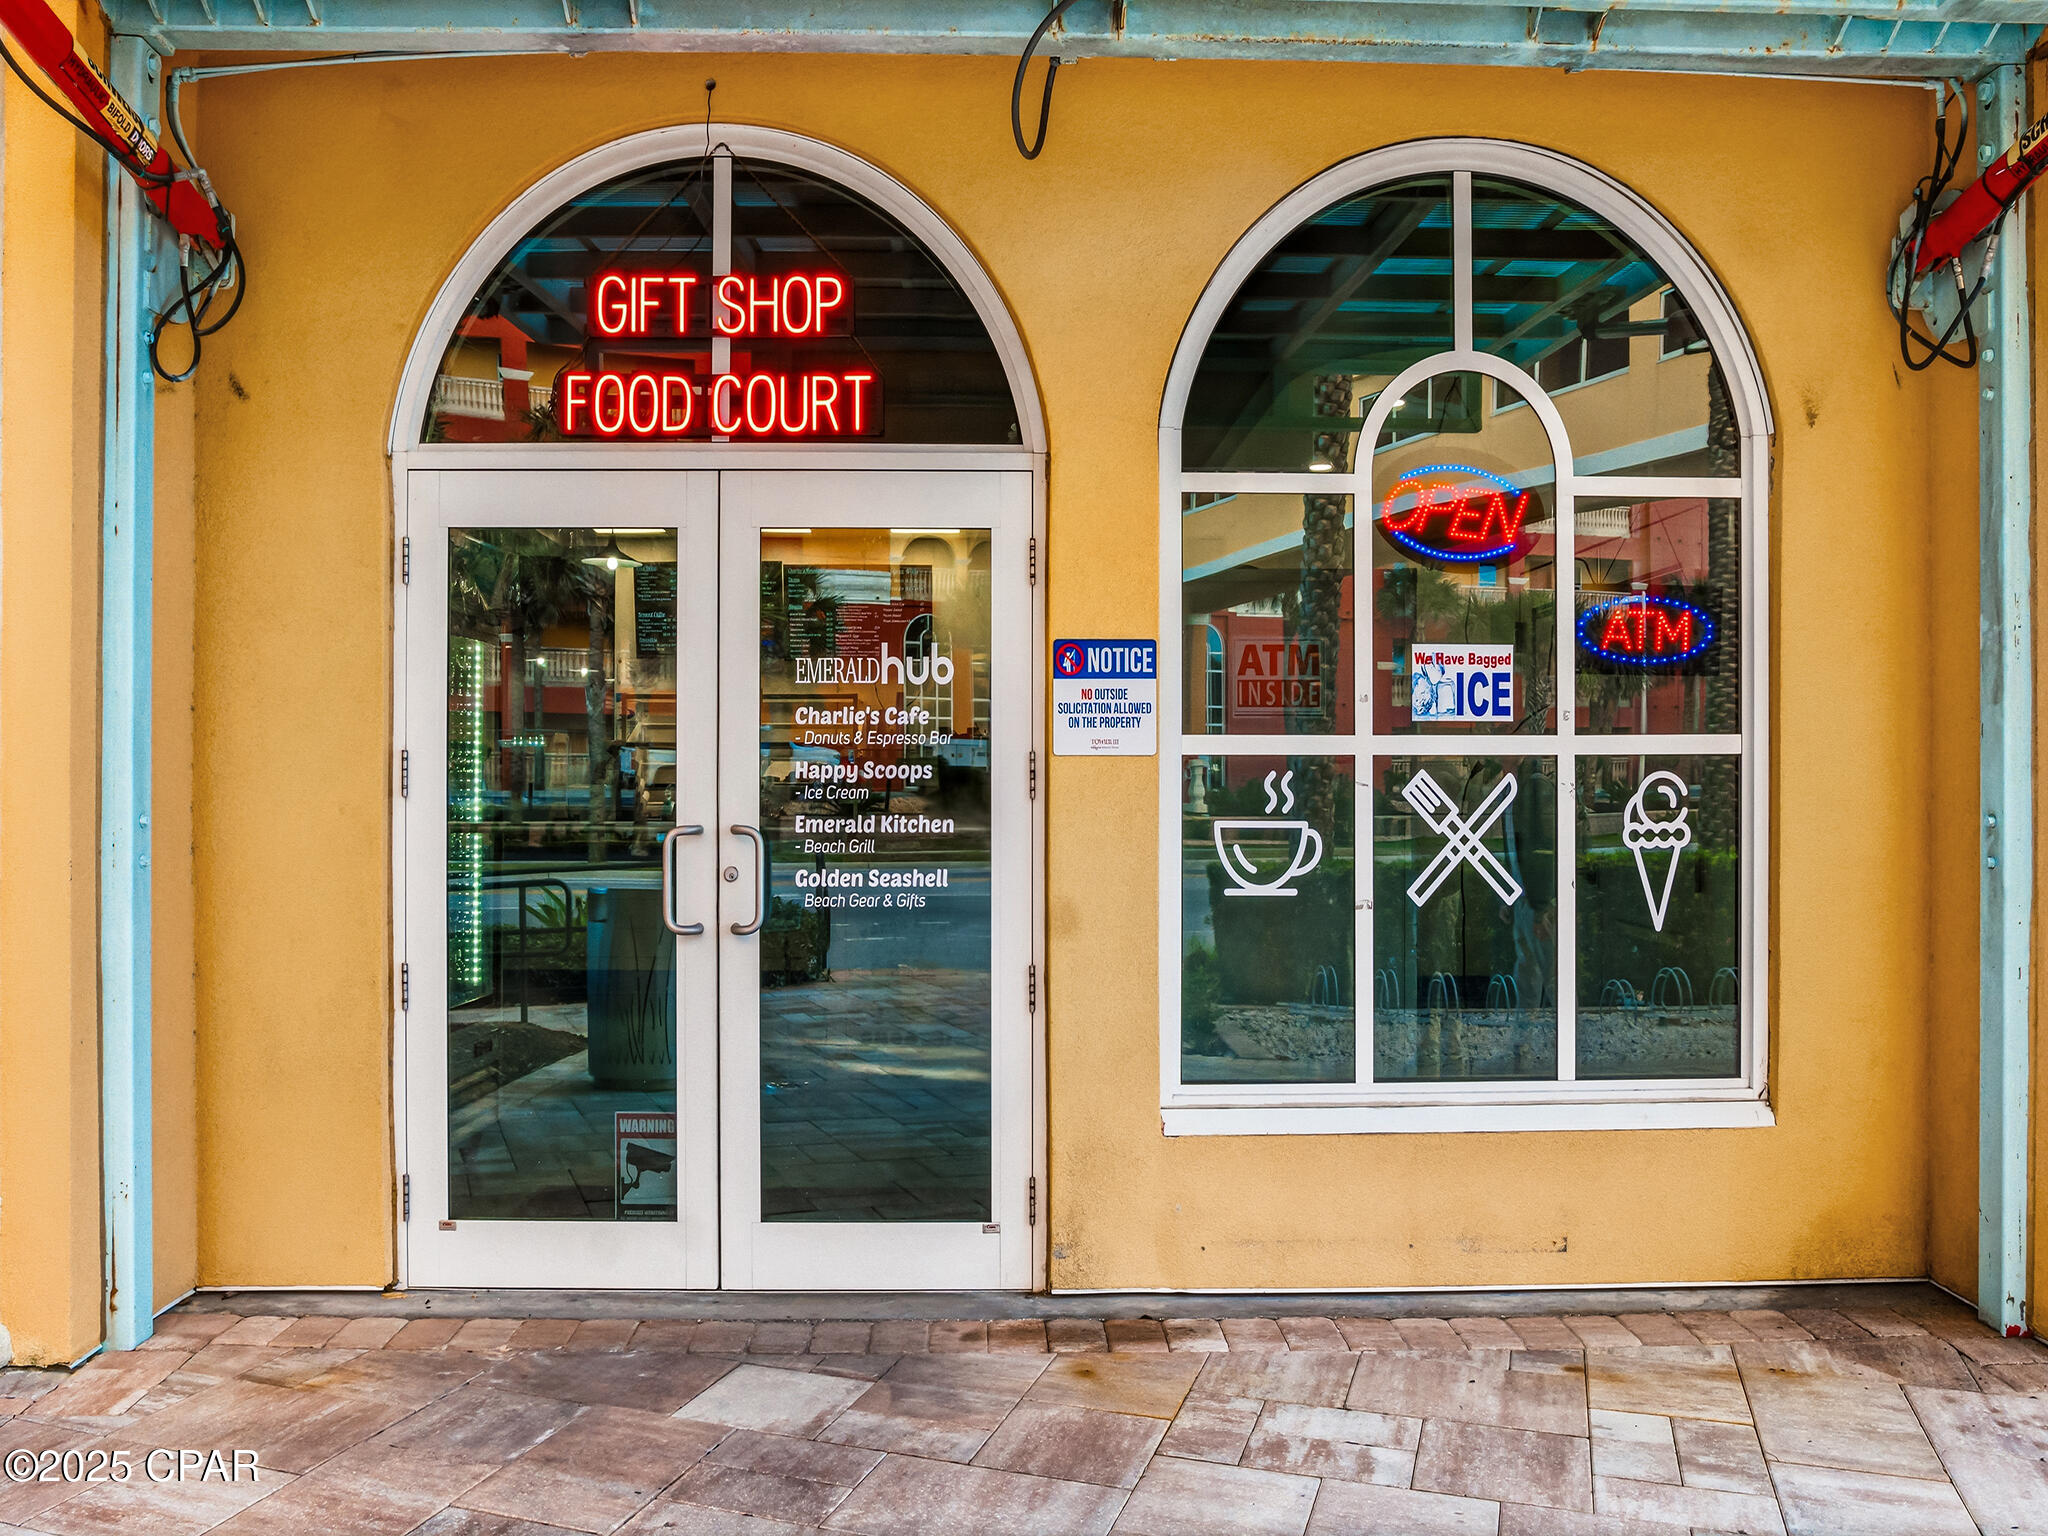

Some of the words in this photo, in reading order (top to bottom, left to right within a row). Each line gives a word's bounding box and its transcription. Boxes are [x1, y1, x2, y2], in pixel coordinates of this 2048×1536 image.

[107, 102, 131, 132] BIFOLD
[596, 274, 697, 335] GIFT
[716, 274, 843, 335] SHOP
[565, 373, 694, 434] FOOD
[711, 373, 873, 434] COURT
[1382, 478, 1530, 543] OPEN
[1601, 609, 1692, 652] ATM
[1087, 647, 1153, 673] NOTICE
[1237, 644, 1320, 676] ATM
[1414, 653, 1433, 666] We
[1435, 653, 1464, 666] Have
[1468, 653, 1512, 669] Bagged
[1081, 688, 1093, 700] NO
[1094, 688, 1128, 700] OUTSIDE
[1237, 680, 1319, 707] INSIDE
[1456, 671, 1511, 717] ICE
[795, 706, 880, 725] Charlie's
[884, 706, 930, 725] Cafe
[1057, 702, 1112, 714] SOLICITATION
[1113, 702, 1152, 714] ALLOWED
[1068, 716, 1080, 728] ON
[1082, 716, 1098, 728] THE
[1099, 716, 1142, 728] PROPERTY
[804, 731, 850, 745] Donuts
[853, 731, 863, 745] &
[867, 731, 926, 747] Espresso
[929, 731, 953, 745] Bar
[795, 761, 858, 783] Happy
[863, 761, 933, 783] Scoops
[804, 785, 823, 799] Ice
[826, 785, 869, 799] Cream
[795, 815, 875, 833] Emerald
[880, 815, 955, 833] Kitchen
[804, 839, 845, 853] Beach
[849, 839, 875, 853] Grill
[795, 869, 863, 887] Golden
[868, 869, 949, 887] Seashell
[804, 893, 845, 907] Beach
[849, 893, 880, 907] Gear
[883, 893, 893, 907] &
[896, 893, 926, 910] Gifts
[620, 1118, 675, 1133] WARNING
